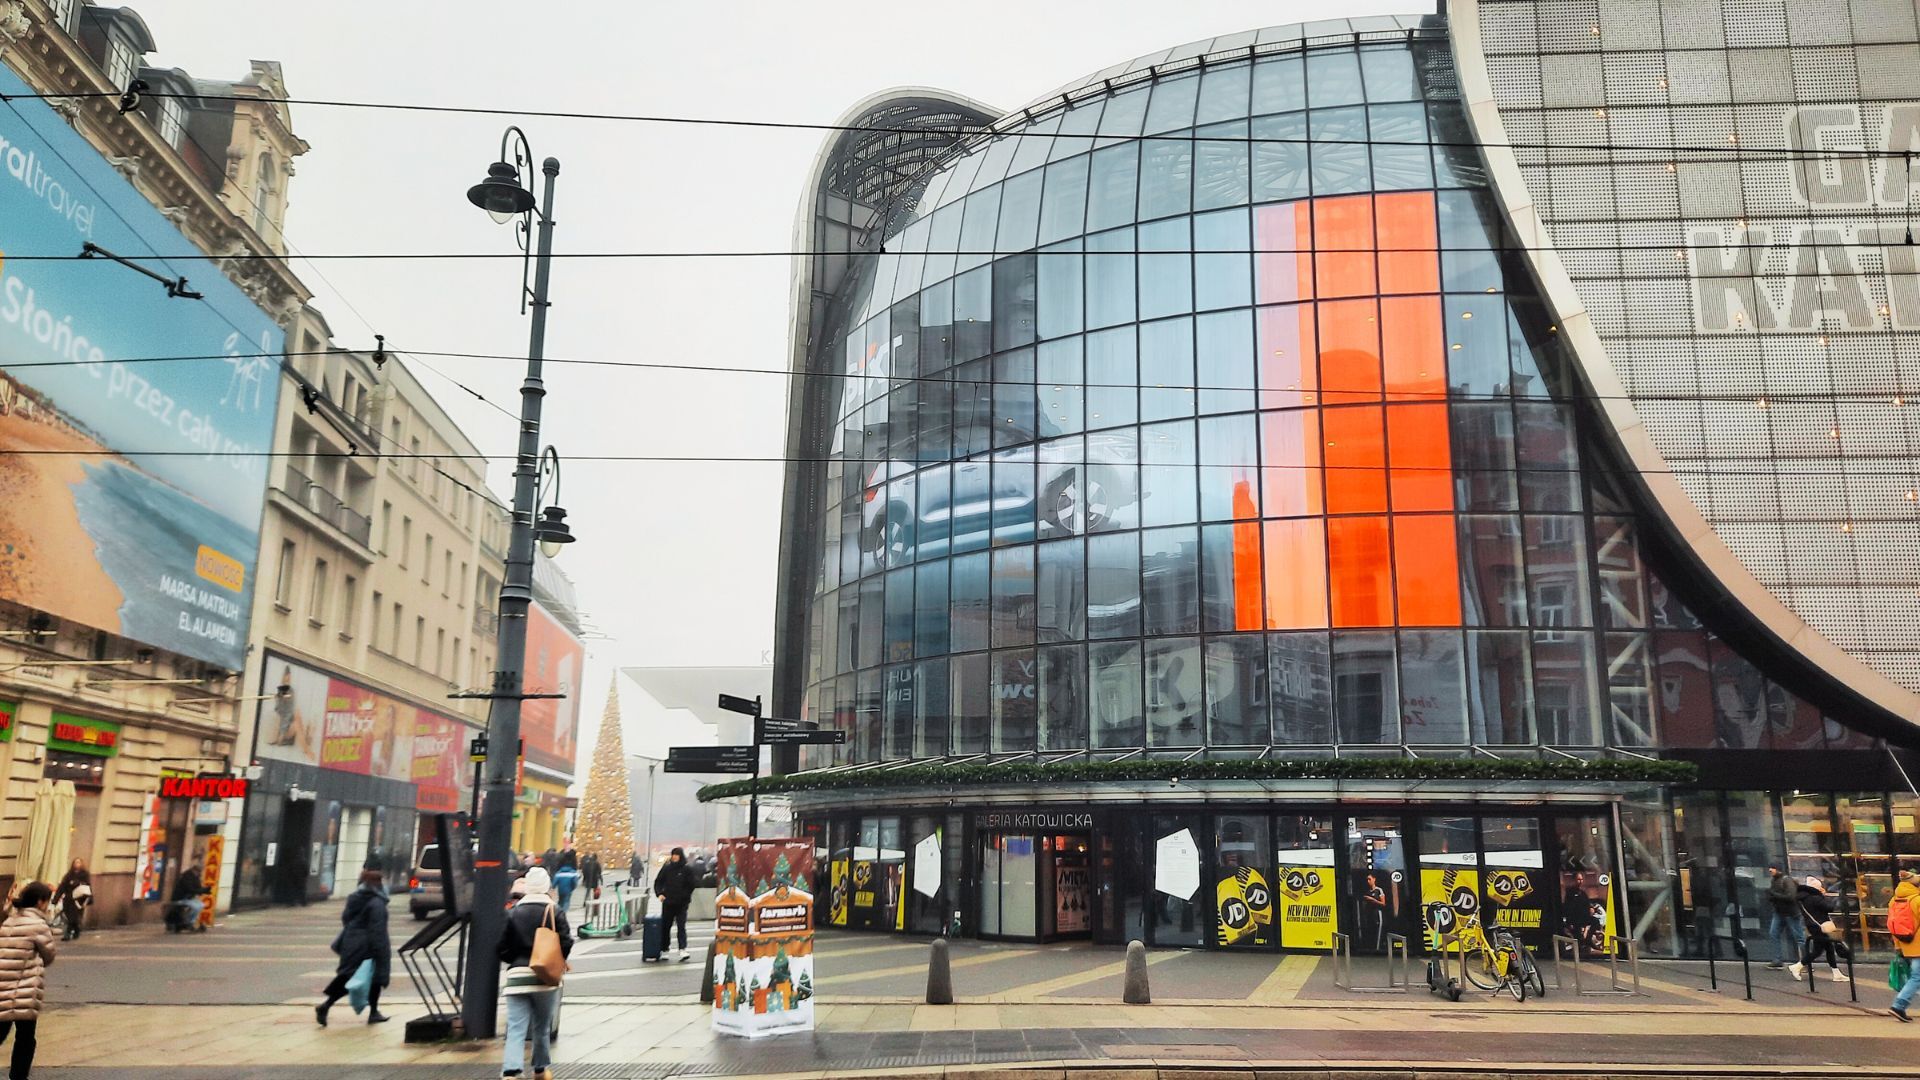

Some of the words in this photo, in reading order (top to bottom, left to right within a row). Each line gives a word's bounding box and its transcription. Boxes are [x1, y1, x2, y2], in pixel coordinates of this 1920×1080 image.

[3, 277, 104, 378] Słońce
[108, 364, 175, 427] przez
[179, 408, 221, 462] cały
[160, 575, 196, 606] MARSA
[198, 591, 240, 620] MATRUH
[179, 612, 192, 632] EL
[192, 615, 236, 646] ALAMEIN
[162, 777, 247, 797] KANTOR
[975, 813, 1011, 827] GALERIA
[1014, 813, 1093, 827] KATOWICKA
[1288, 875, 1303, 888] JD
[1309, 874, 1319, 886] JD
[1495, 879, 1511, 892] JD
[1517, 878, 1527, 889] JD
[1247, 889, 1268, 905] JD
[1453, 893, 1475, 909] JD
[1228, 902, 1246, 925] JD
[1287, 904, 1302, 917] NEW
[1302, 904, 1311, 917] IN
[1311, 904, 1332, 918] TOWN!
[1496, 908, 1511, 922] NEW
[1511, 908, 1520, 922] IN
[1520, 908, 1542, 922] TOWN!
